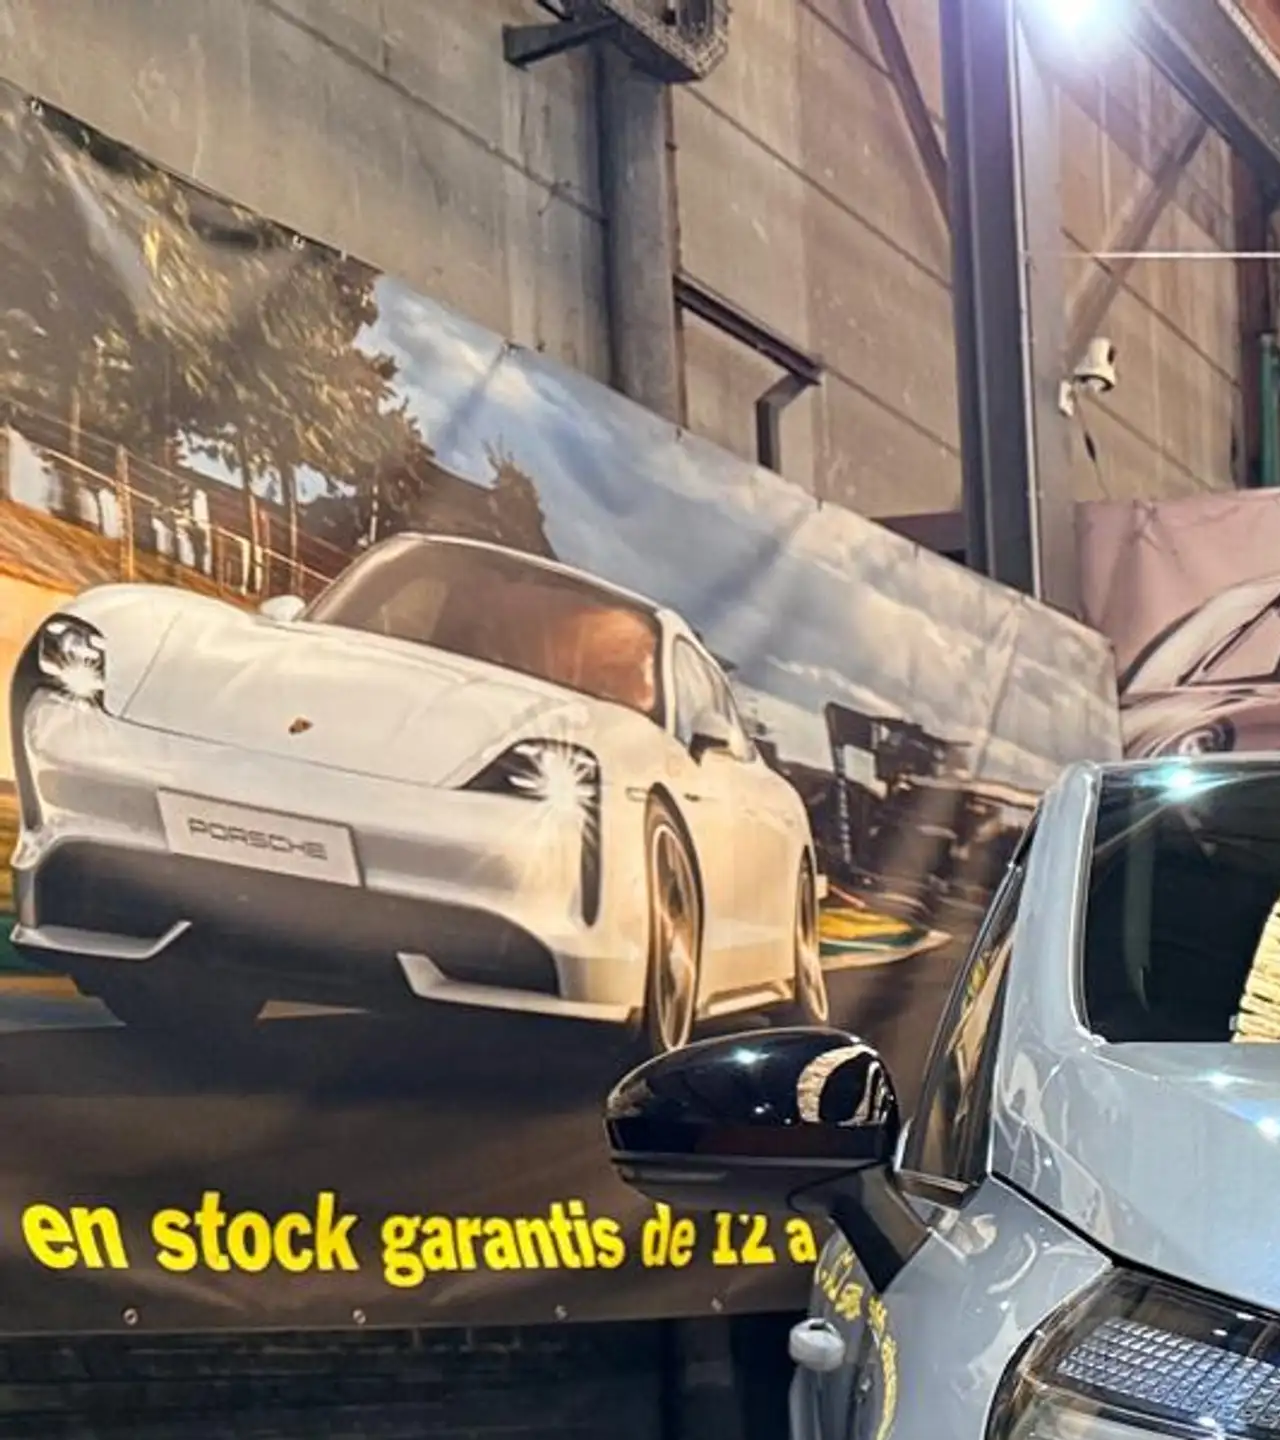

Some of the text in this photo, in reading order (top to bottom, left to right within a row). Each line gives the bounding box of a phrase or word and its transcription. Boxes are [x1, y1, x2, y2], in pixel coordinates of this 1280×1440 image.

[188, 818, 328, 860] PORSCHE
[22, 1203, 128, 1270] en
[151, 1191, 360, 1272] stock
[381, 1199, 626, 1288] garantis
[641, 1202, 696, 1267] de
[712, 1212, 776, 1266] 12
